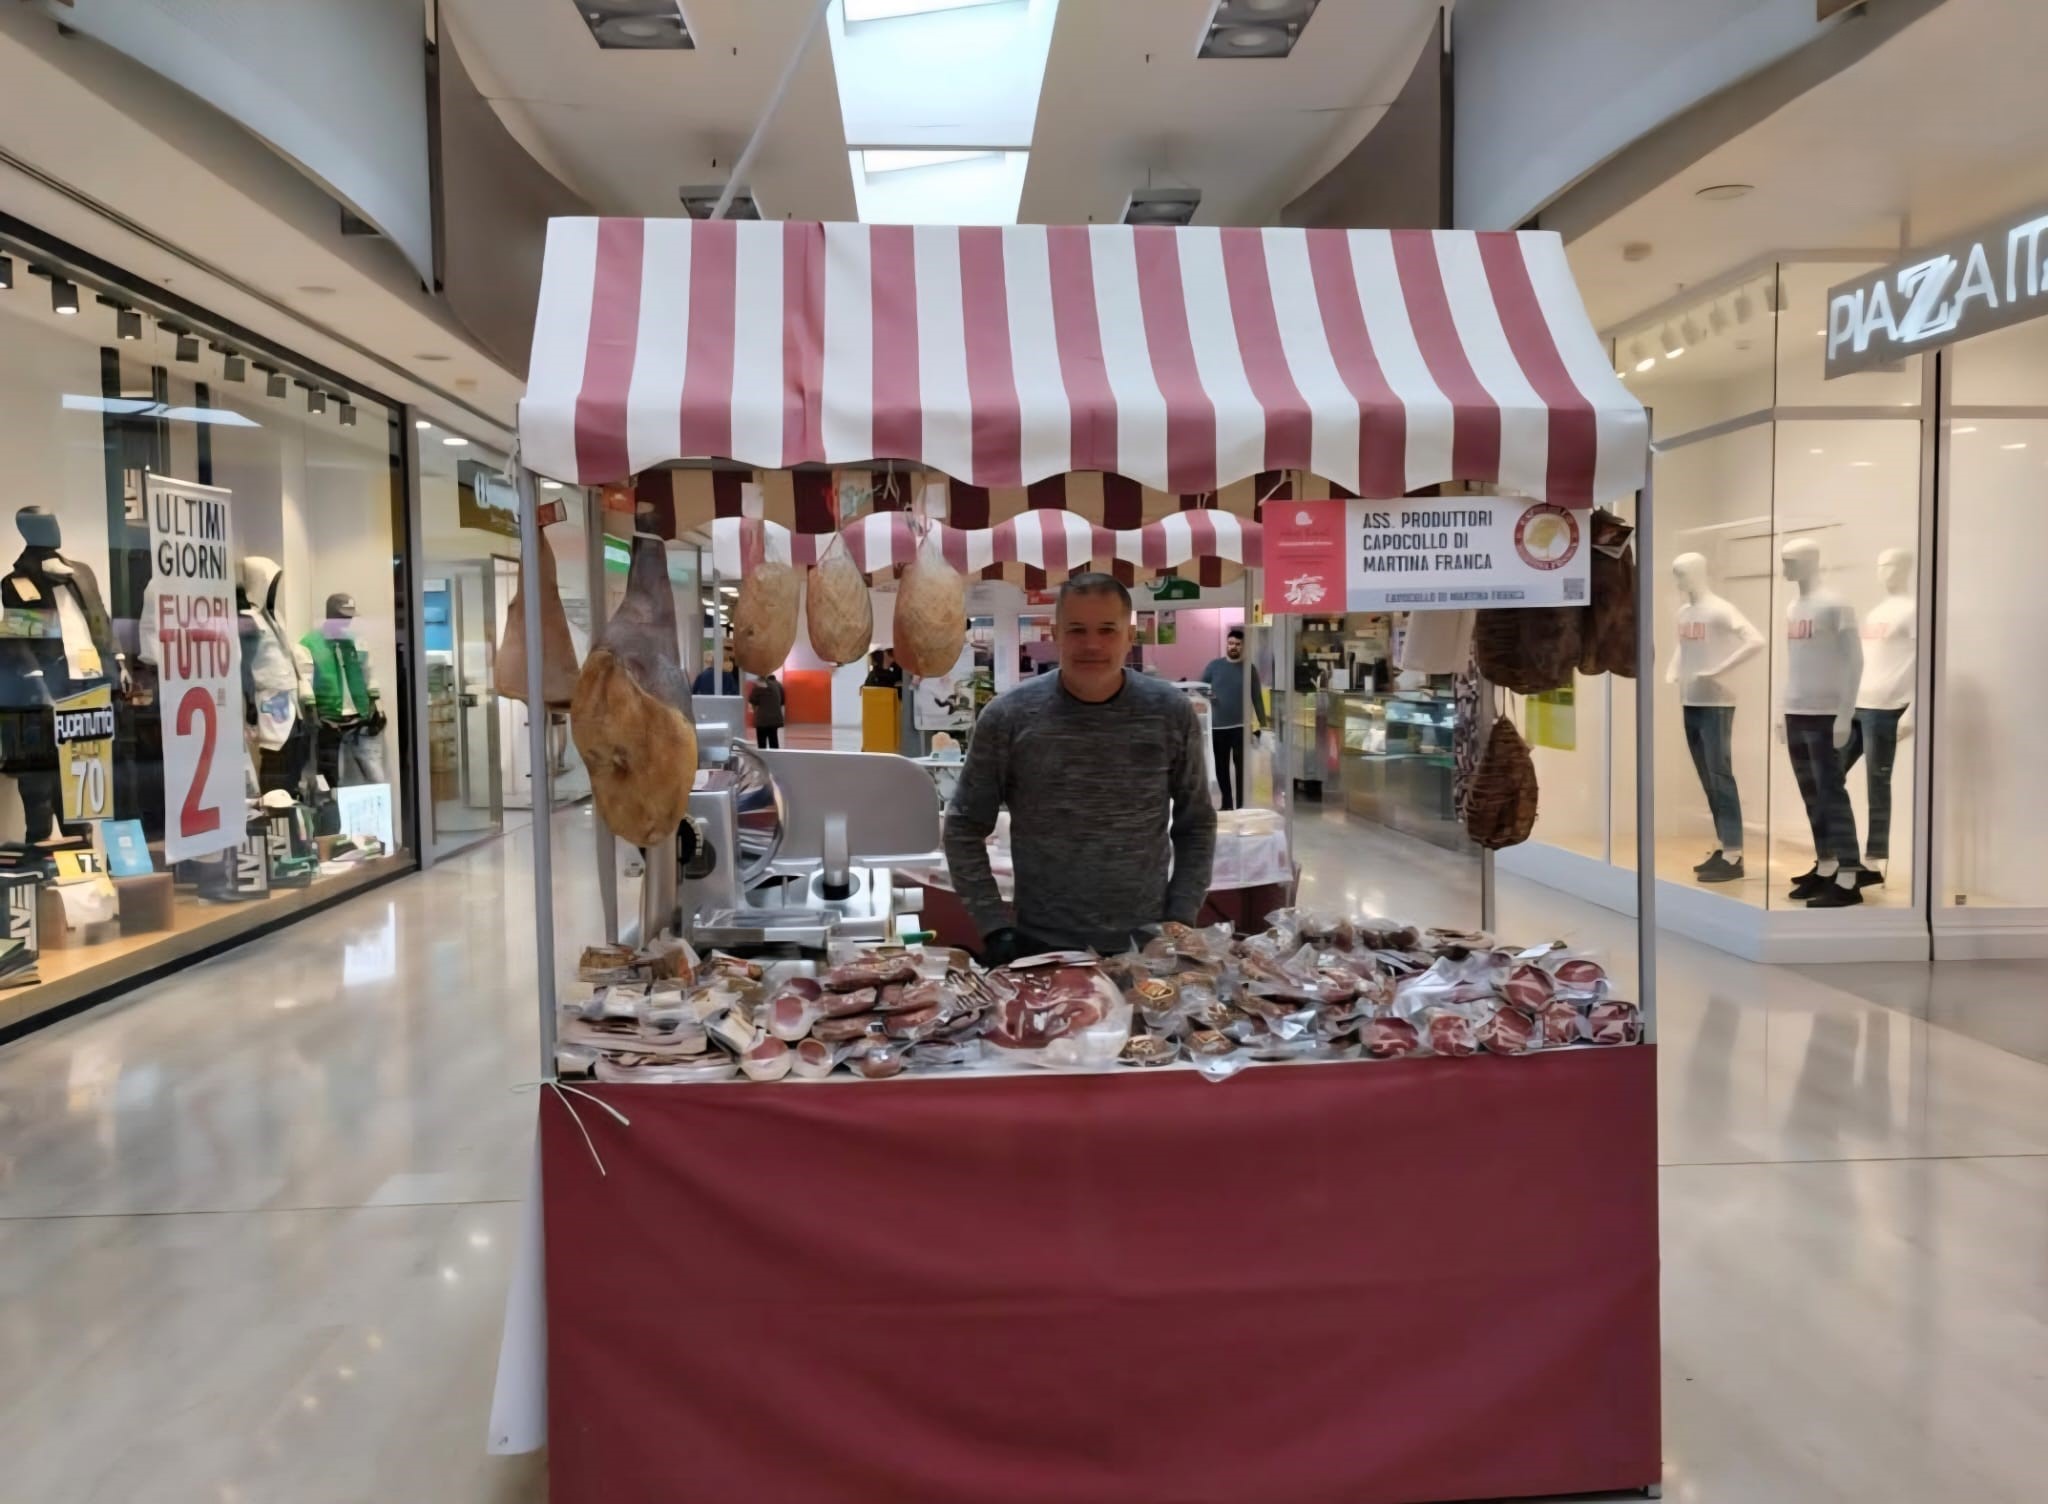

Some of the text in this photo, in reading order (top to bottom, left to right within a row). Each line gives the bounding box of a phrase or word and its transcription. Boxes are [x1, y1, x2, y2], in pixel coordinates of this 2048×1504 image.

[2006, 214, 2048, 302] IT
[156, 493, 226, 541] ULTIMI
[1363, 510, 1492, 528] ASS. PRODUTTORI
[157, 540, 227, 580] GIORNI
[1363, 532, 1468, 550] CAPOCOLLO DI
[1363, 554, 1492, 572] MARTINA FRANCA
[158, 594, 229, 628] FUORI
[158, 628, 231, 681] TUTTO
[176, 686, 220, 838] 2
[71, 758, 105, 817] 70
